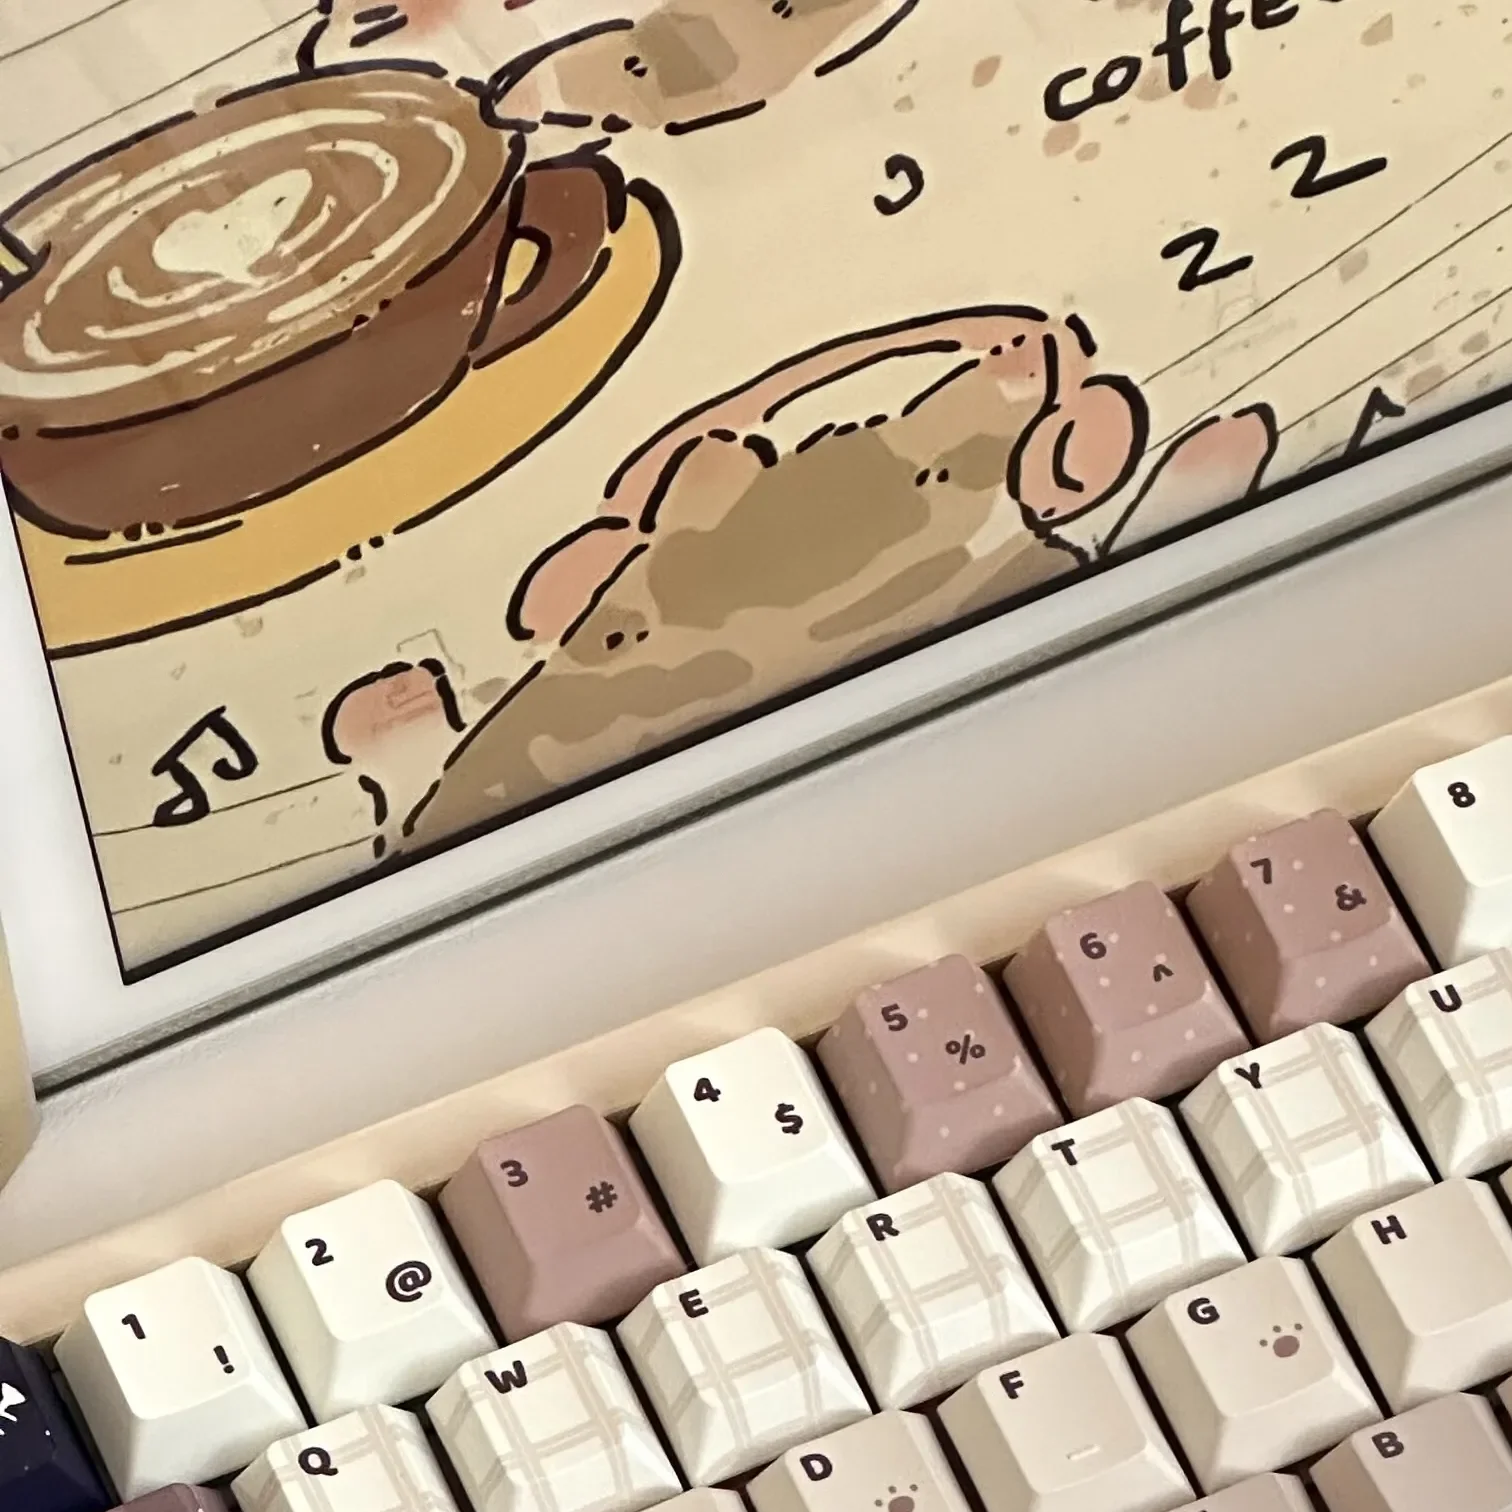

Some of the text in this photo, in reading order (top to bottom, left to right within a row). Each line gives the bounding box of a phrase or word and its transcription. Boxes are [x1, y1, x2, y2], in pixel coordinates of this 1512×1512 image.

[1043, 0, 1343, 122] coffe
[1447, 781, 1476, 808] 8
[1250, 857, 1273, 885] 7
[1079, 932, 1107, 960] 6
[1428, 984, 1463, 1013] U
[881, 1003, 909, 1032] 5
[693, 1077, 721, 1103] 4
[1233, 1062, 1262, 1090] Y
[1050, 1138, 1078, 1167] T
[500, 1159, 529, 1188] 3
[865, 1213, 900, 1242] R
[1370, 1214, 1407, 1245] H
[305, 1238, 334, 1267] 2
[678, 1288, 709, 1319] E
[1187, 1297, 1220, 1325] G
[121, 1313, 146, 1340] 1
[483, 1360, 528, 1395] W
[999, 1370, 1024, 1400] F
[1371, 1431, 1405, 1459] B
[297, 1446, 339, 1477] Q
[799, 1453, 833, 1482] D
